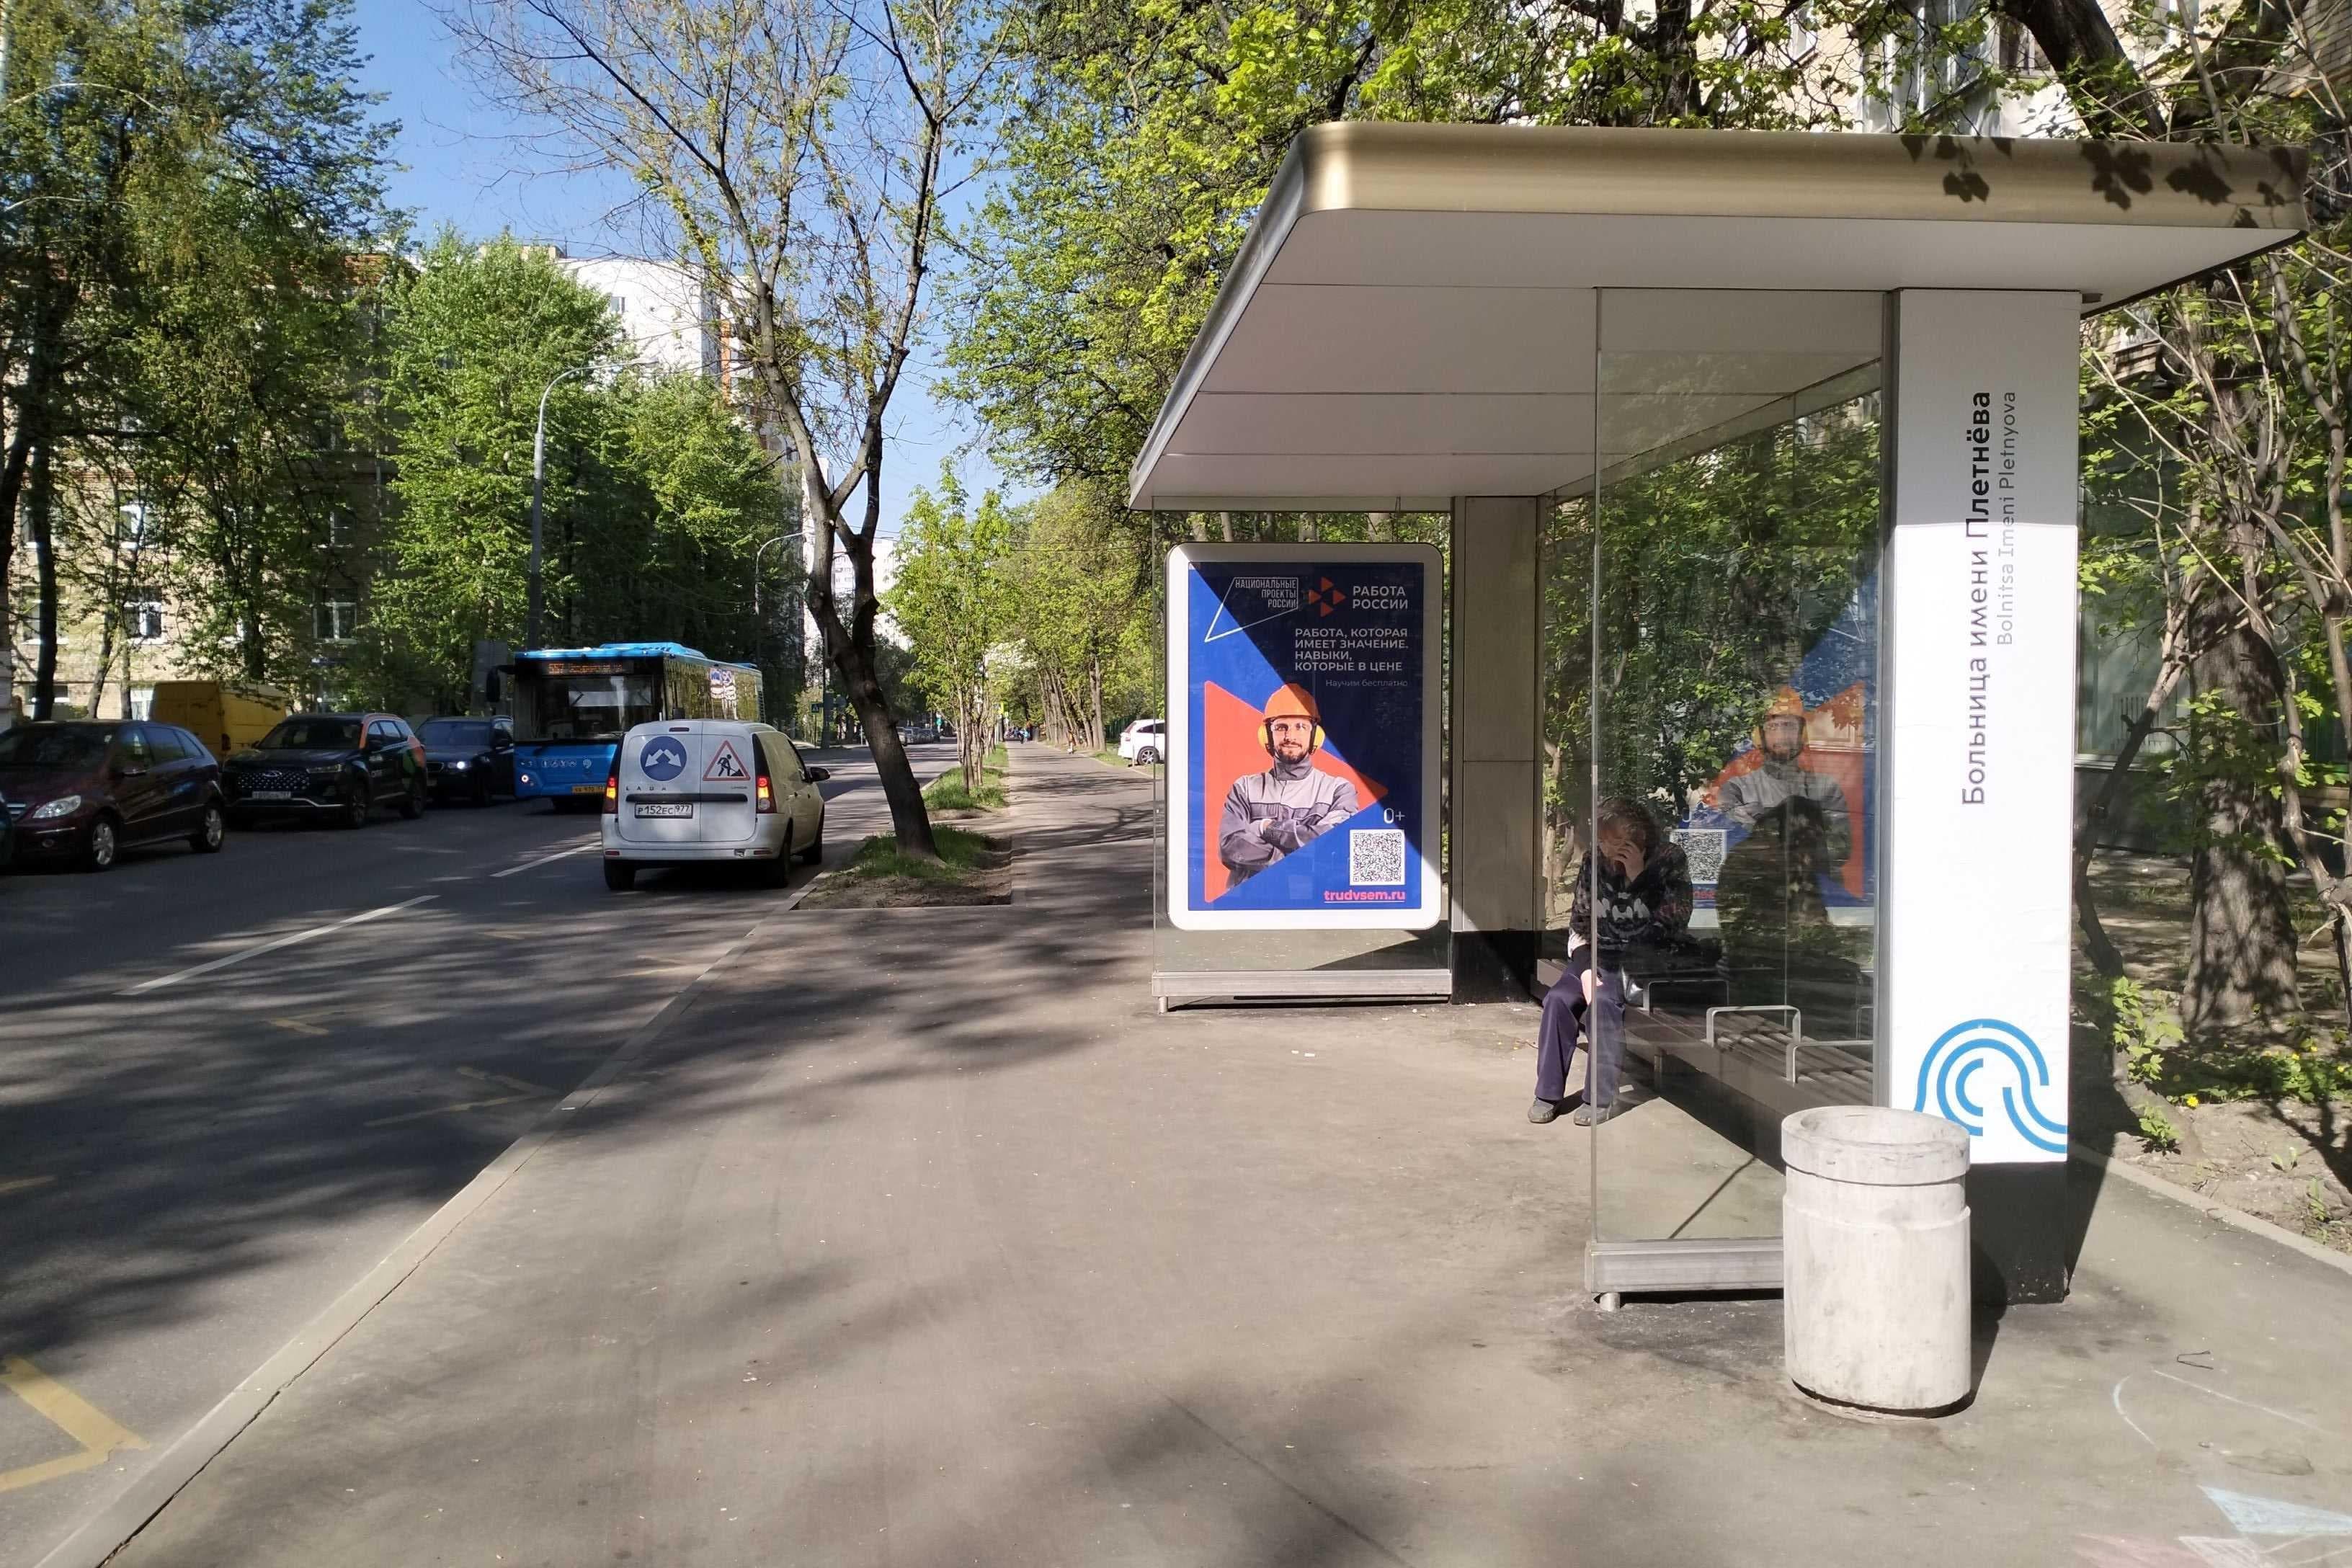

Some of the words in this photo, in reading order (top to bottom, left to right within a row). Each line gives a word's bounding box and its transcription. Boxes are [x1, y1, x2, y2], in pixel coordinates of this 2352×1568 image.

[1998, 391, 2018, 489] Pletnyova
[1966, 392, 1990, 538] Плетнёва
[1998, 497, 2015, 557] Imeni
[1235, 579, 1296, 589] НАЦИОНАЛЬНЫЕ
[1261, 589, 1296, 599] ПРОЕКТЫ
[1353, 585, 1406, 597] РАБОТА
[1268, 599, 1296, 608] РОССИИ
[1353, 598, 1408, 610] РОССИИ
[1970, 551, 1988, 646] имени
[1997, 564, 2014, 645] Bolnitsa
[1295, 628, 1348, 639] РАБОТА,
[1350, 628, 1407, 638] КОТОРАЯ
[1295, 639, 1337, 649] ИМЕЕТ
[1340, 638, 1409, 649] ЗНАЧЕНИЕ.
[1295, 650, 1353, 662] НАВЫКИ,
[1295, 662, 1355, 672] КОТОРЫЕ
[1358, 662, 1366, 671] В
[1370, 661, 1402, 673] ЦЕНЕ
[1326, 679, 1359, 687] Научим
[1362, 679, 1408, 688] бесплатно
[1961, 657, 1990, 804] Больница
[1384, 808, 1405, 824] 0+
[1324, 889, 1405, 901] trudvsem.ru
